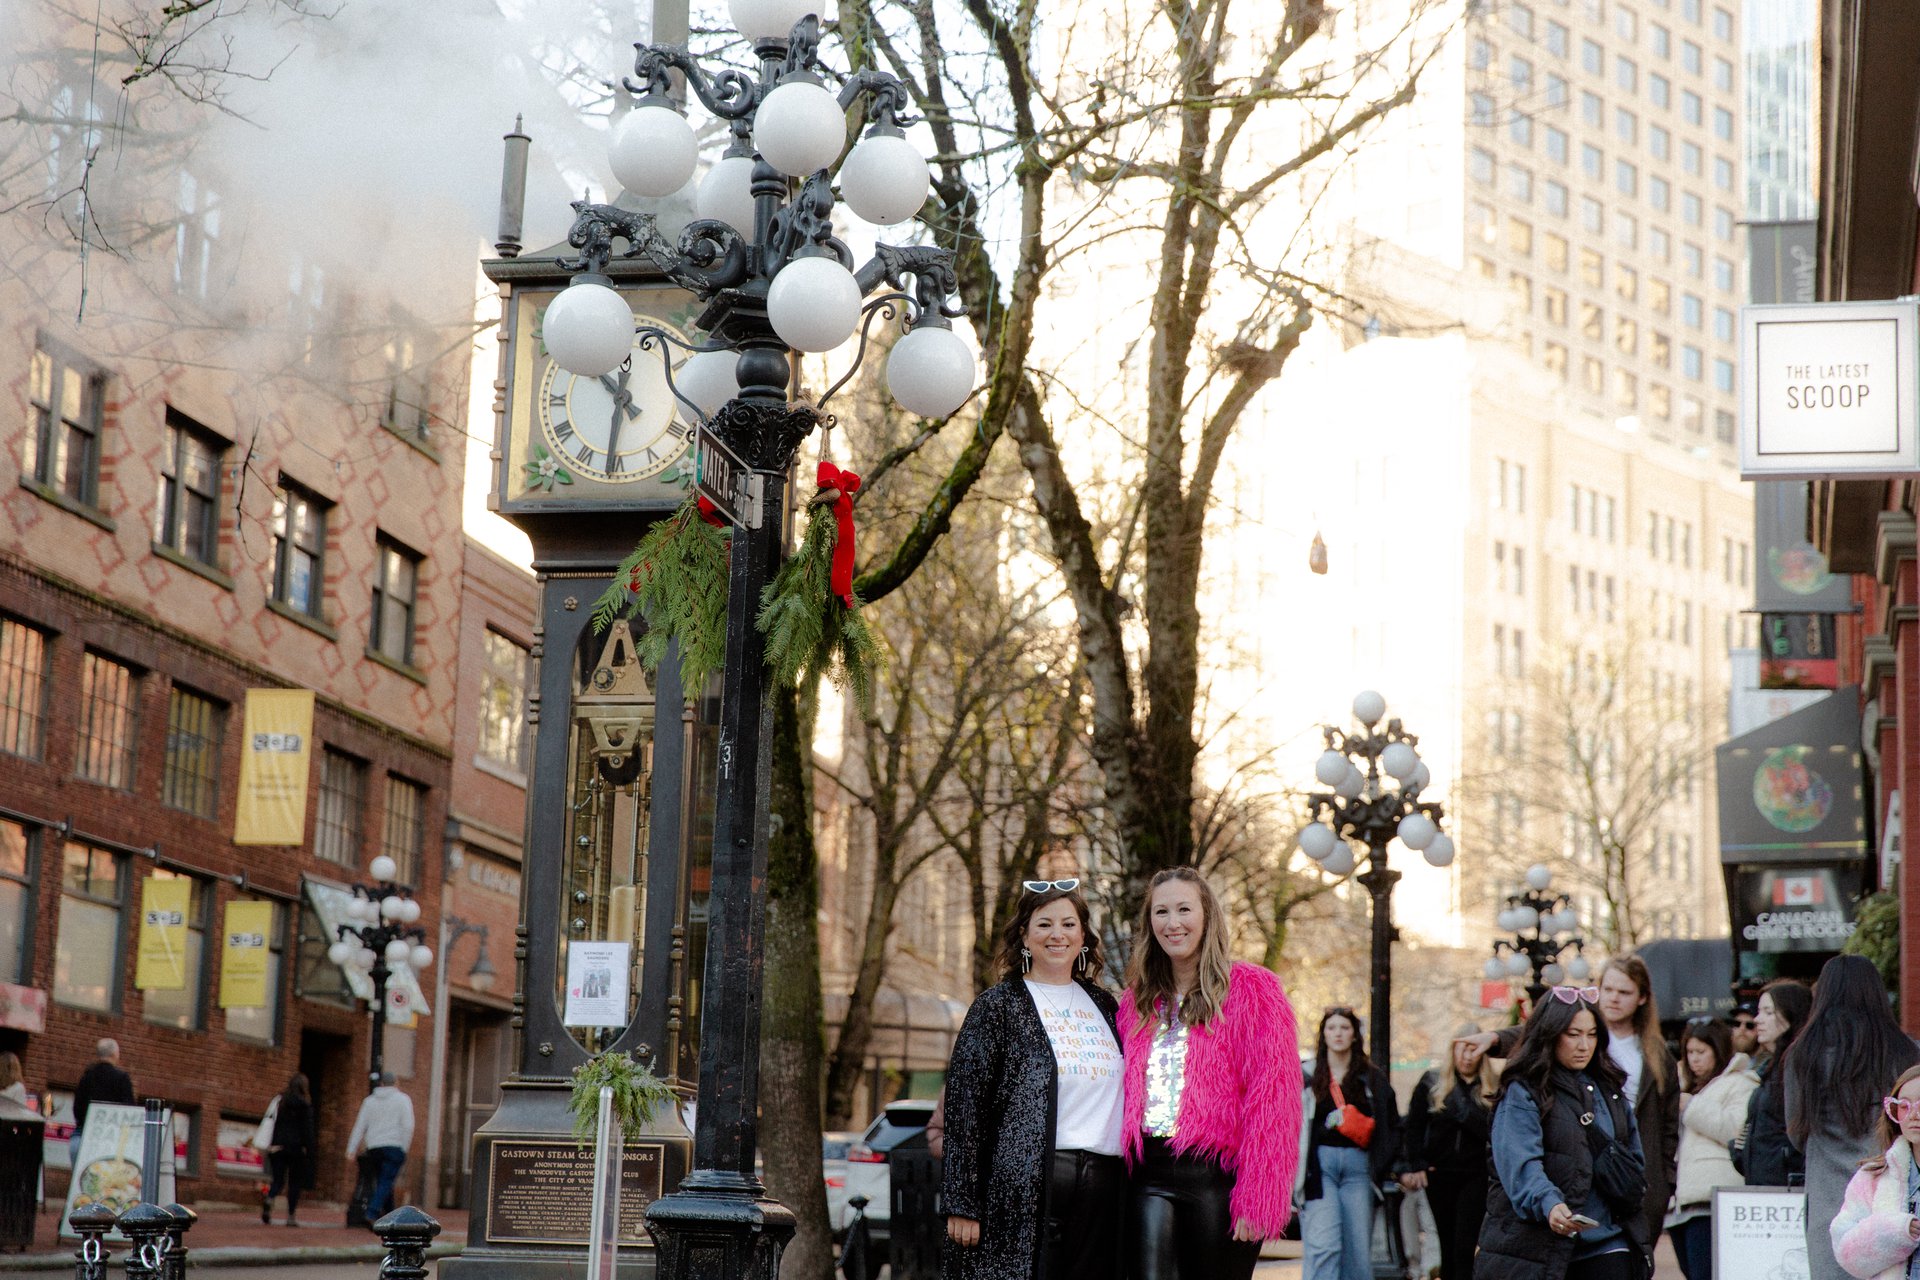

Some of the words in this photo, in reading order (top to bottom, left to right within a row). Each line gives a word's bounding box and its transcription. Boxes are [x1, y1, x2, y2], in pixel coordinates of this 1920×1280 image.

[1786, 365, 1811, 379] THE
[1820, 364, 1870, 379] LATEST
[1787, 385, 1870, 409] SCOOP
[702, 440, 730, 501] WATER
[1756, 911, 1843, 925] CANADIAN
[1743, 924, 1789, 940] GEMS
[1790, 925, 1802, 939] &
[1803, 922, 1858, 938] ROCKS
[1074, 1009, 1094, 1020] the
[1069, 1022, 1082, 1032] of
[1086, 1025, 1105, 1037] my
[1059, 1036, 1118, 1052] fighting
[1091, 1066, 1115, 1080] you
[501, 1150, 544, 1158] GASTOWN
[547, 1152, 576, 1160] STEAM
